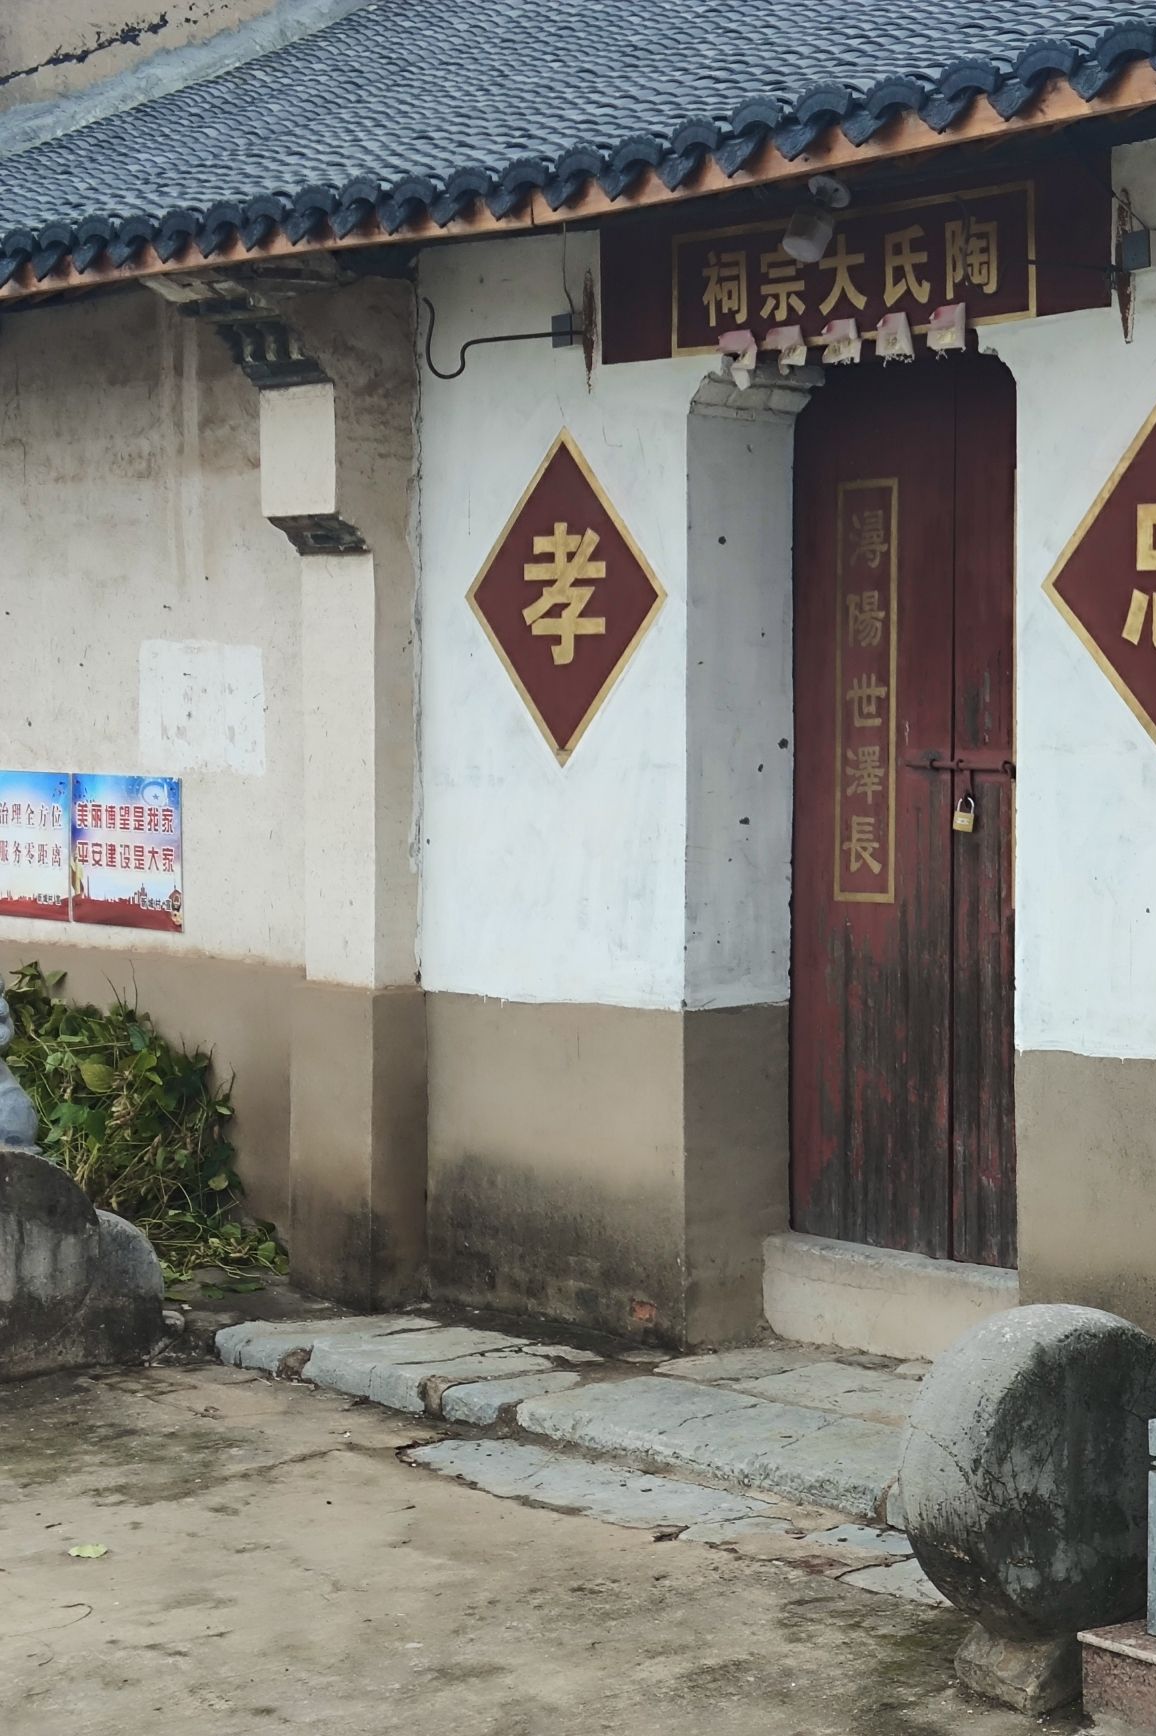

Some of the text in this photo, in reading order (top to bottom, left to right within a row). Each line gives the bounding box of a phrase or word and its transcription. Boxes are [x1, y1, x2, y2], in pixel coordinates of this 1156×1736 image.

[522, 521, 606, 667] 孝
[0, 802, 61, 828] 治理全方位
[77, 803, 174, 833] 美丽博望是我家
[77, 842, 174, 872] 平安建设是大家
